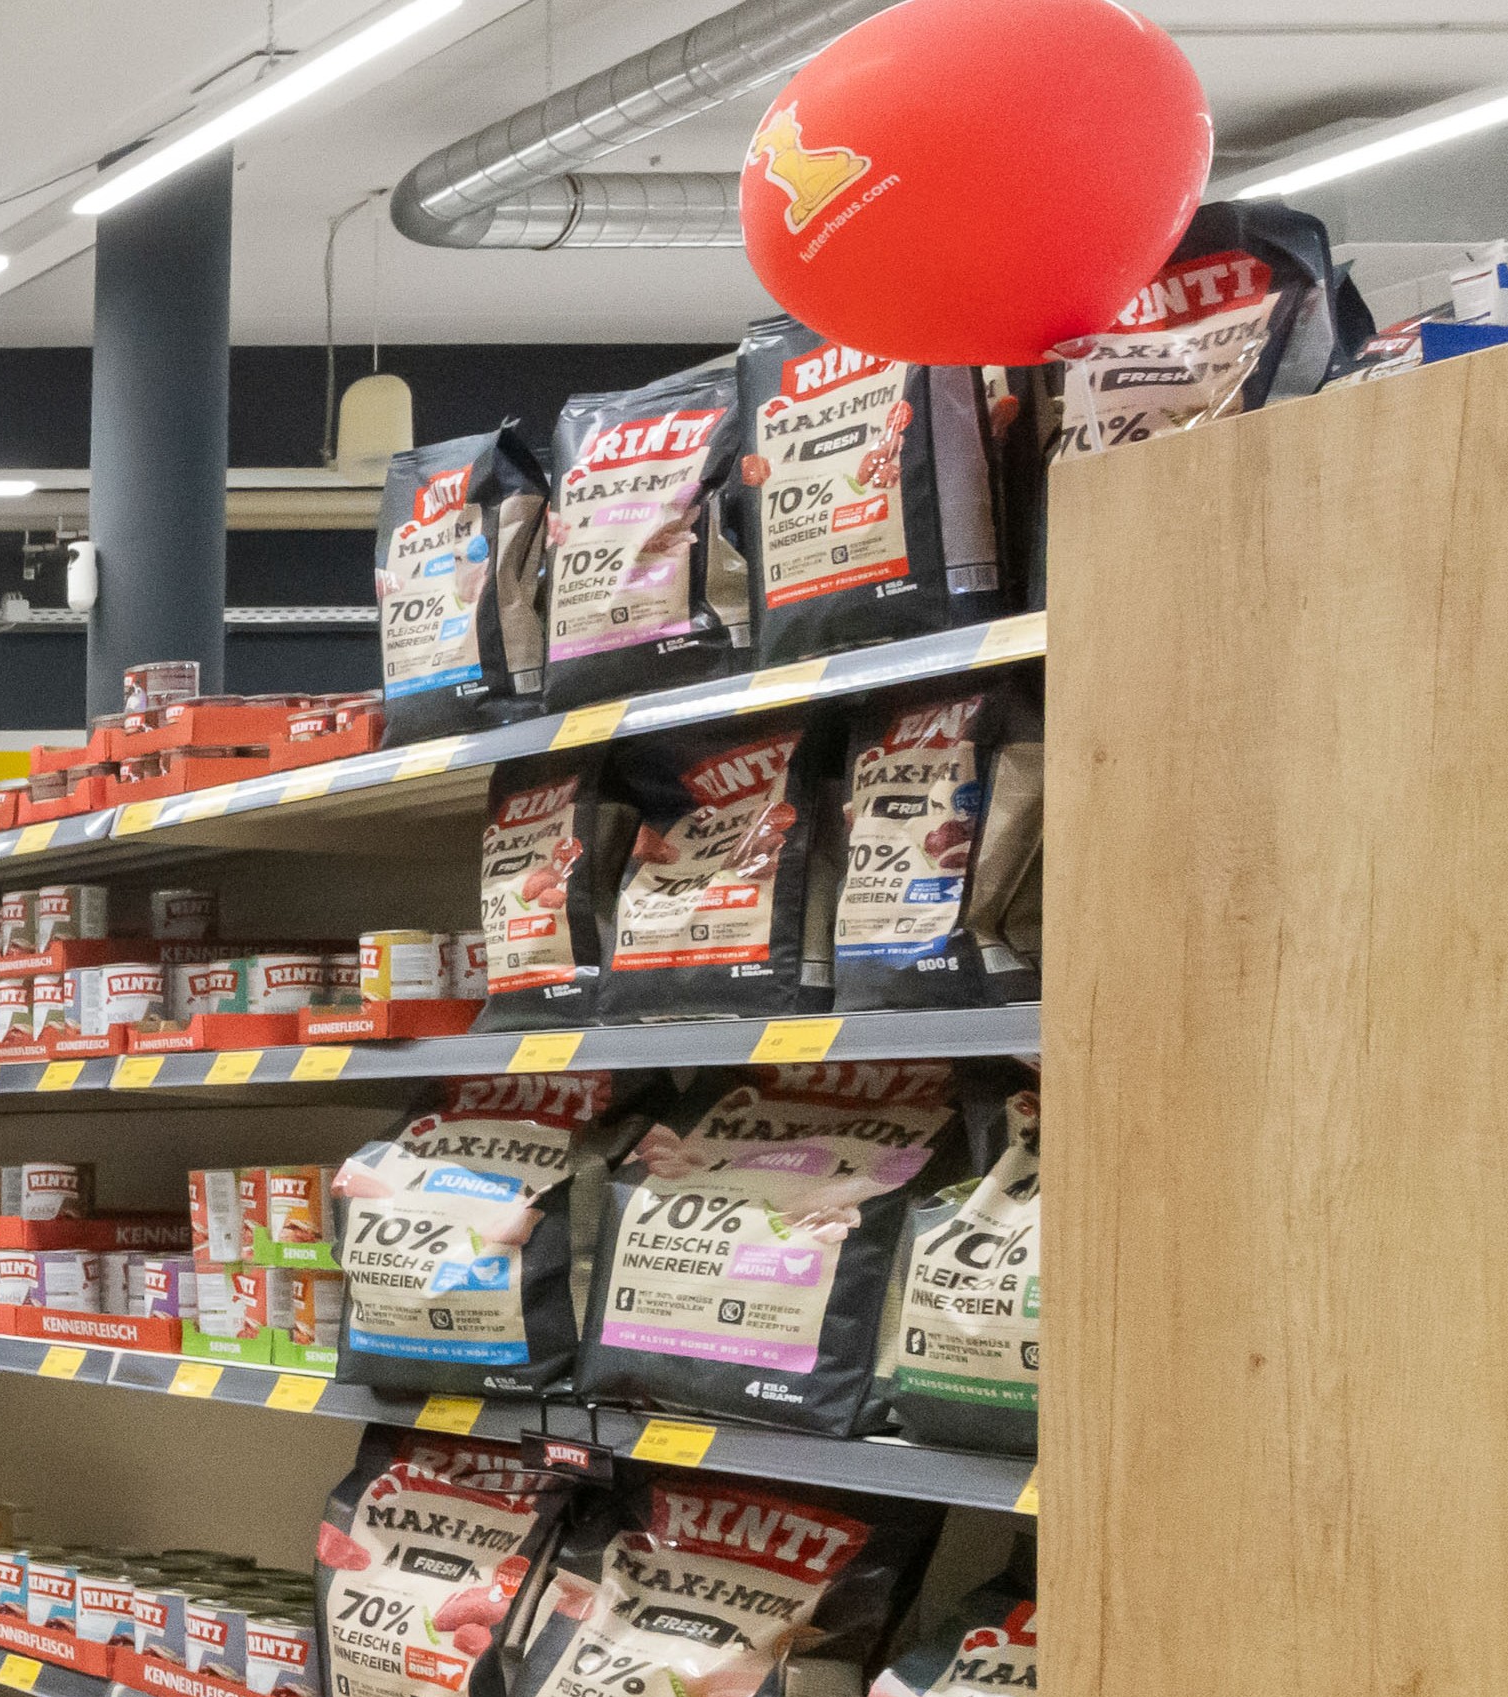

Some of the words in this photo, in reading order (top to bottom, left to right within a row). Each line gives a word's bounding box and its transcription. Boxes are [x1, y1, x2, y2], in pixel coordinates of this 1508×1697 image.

[800, 172, 899, 262] futterhaus.com
[764, 384, 897, 441] MAX-I-MUM
[607, 506, 651, 522] MINI
[389, 597, 444, 622] 70%
[28, 1171, 77, 1192] RINTI
[434, 1171, 511, 1199] JUNIOR
[354, 1211, 456, 1255] 70%
[627, 1231, 713, 1255] FLEISCH
[623, 1253, 724, 1276] INNEREIEN
[42, 1315, 137, 1342] KENNERFLEISCH
[546, 1446, 587, 1468] RINTI
[664, 1493, 849, 1572] RINTI
[413, 1553, 463, 1581] FRESH
[613, 1548, 805, 1624] MAX-I-MUM
[652, 1612, 720, 1644] FRESH
